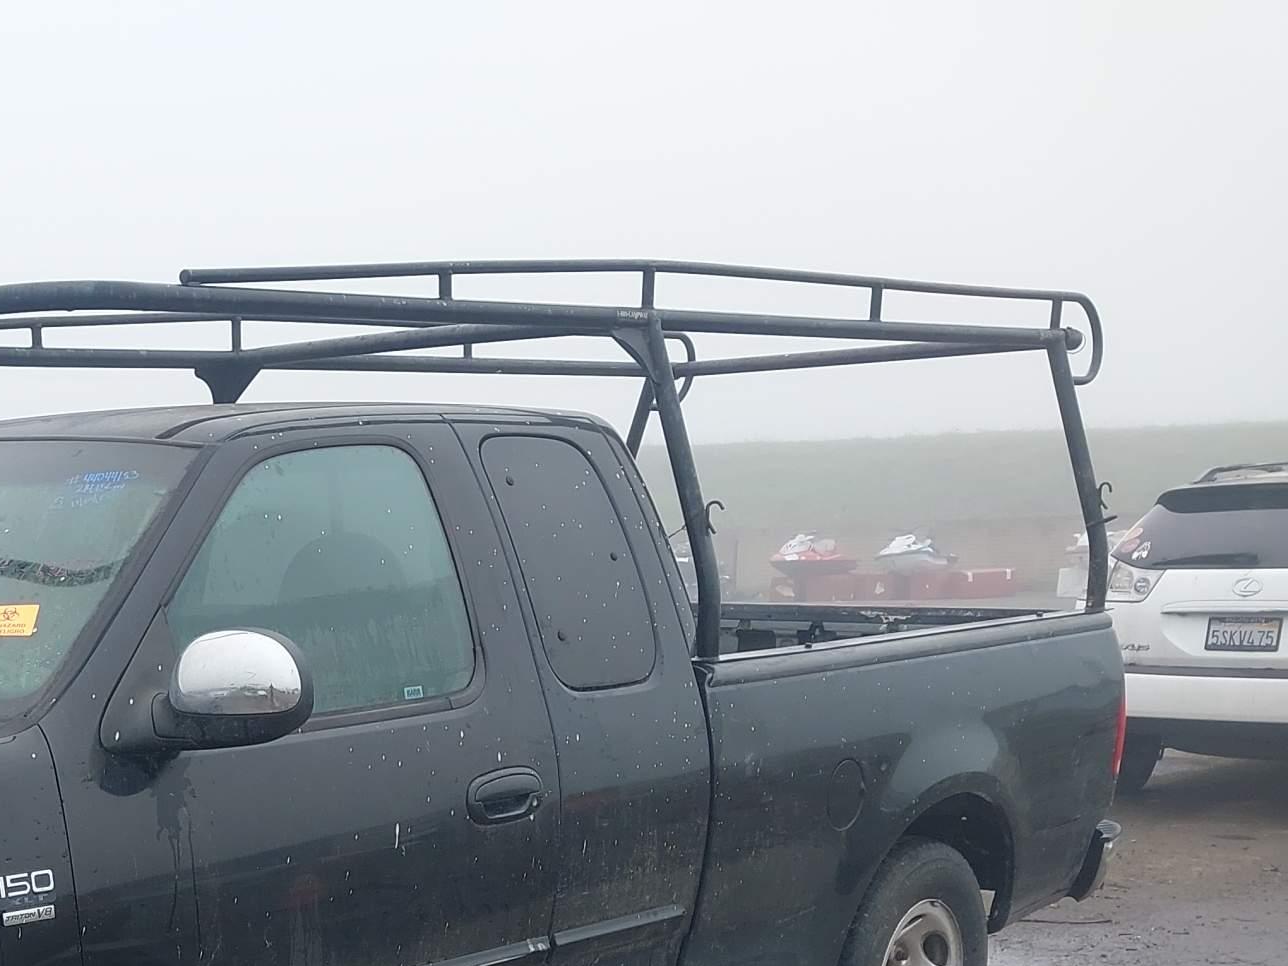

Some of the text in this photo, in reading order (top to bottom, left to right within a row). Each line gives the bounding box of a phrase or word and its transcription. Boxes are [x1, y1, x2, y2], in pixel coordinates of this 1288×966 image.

[1211, 629, 1275, 648] 5SKV475
[8, 893, 49, 906] XLT
[6, 907, 53, 922] TRITON V8
